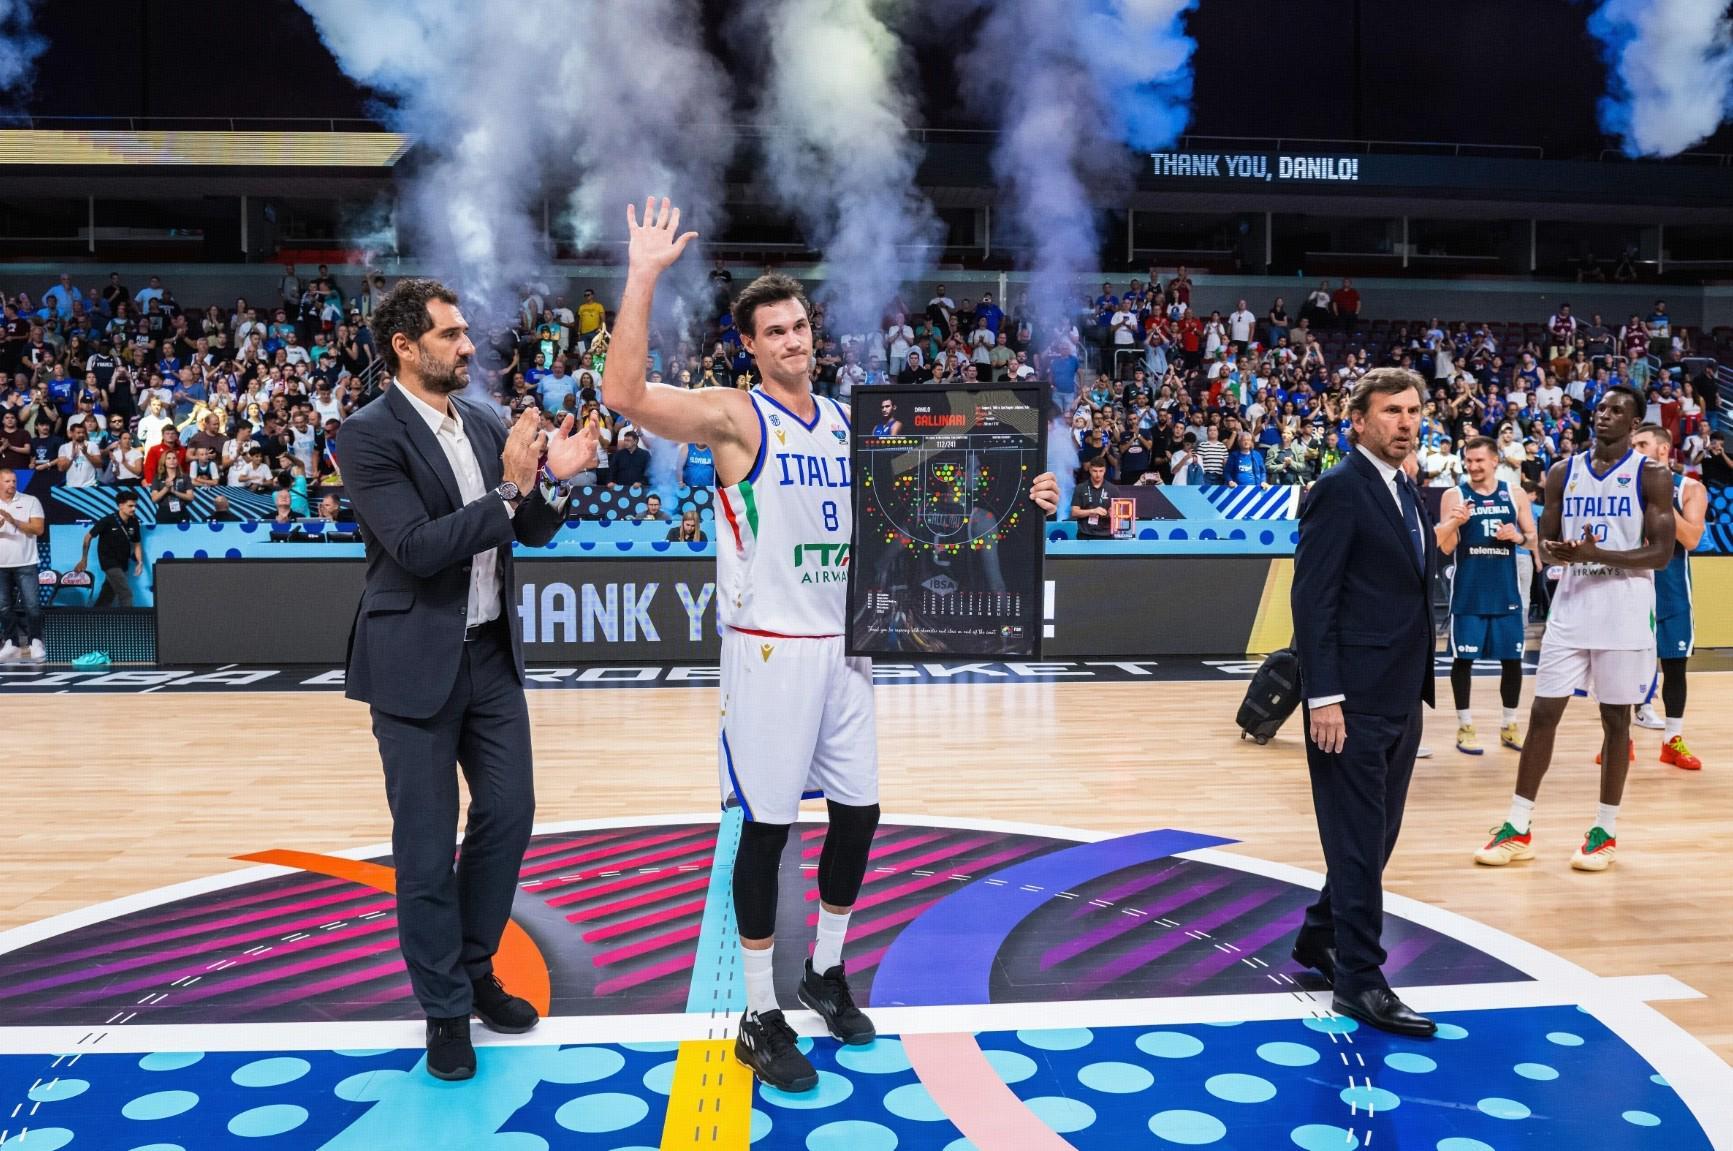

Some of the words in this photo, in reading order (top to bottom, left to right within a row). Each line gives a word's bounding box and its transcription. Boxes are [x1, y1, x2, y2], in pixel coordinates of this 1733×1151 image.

[1151, 153, 1220, 176] THANK
[1224, 155, 1272, 182] YOU,
[1279, 156, 1359, 180] DANILO!
[914, 415, 966, 427] GALLINARI
[776, 453, 851, 488] ITALI
[822, 500, 839, 531] 8
[1564, 496, 1631, 517] ITALIA
[1480, 518, 1502, 537] 15
[1469, 546, 1509, 556] telemach
[801, 570, 850, 584] AIRWA
[929, 579, 955, 590] IBSA
